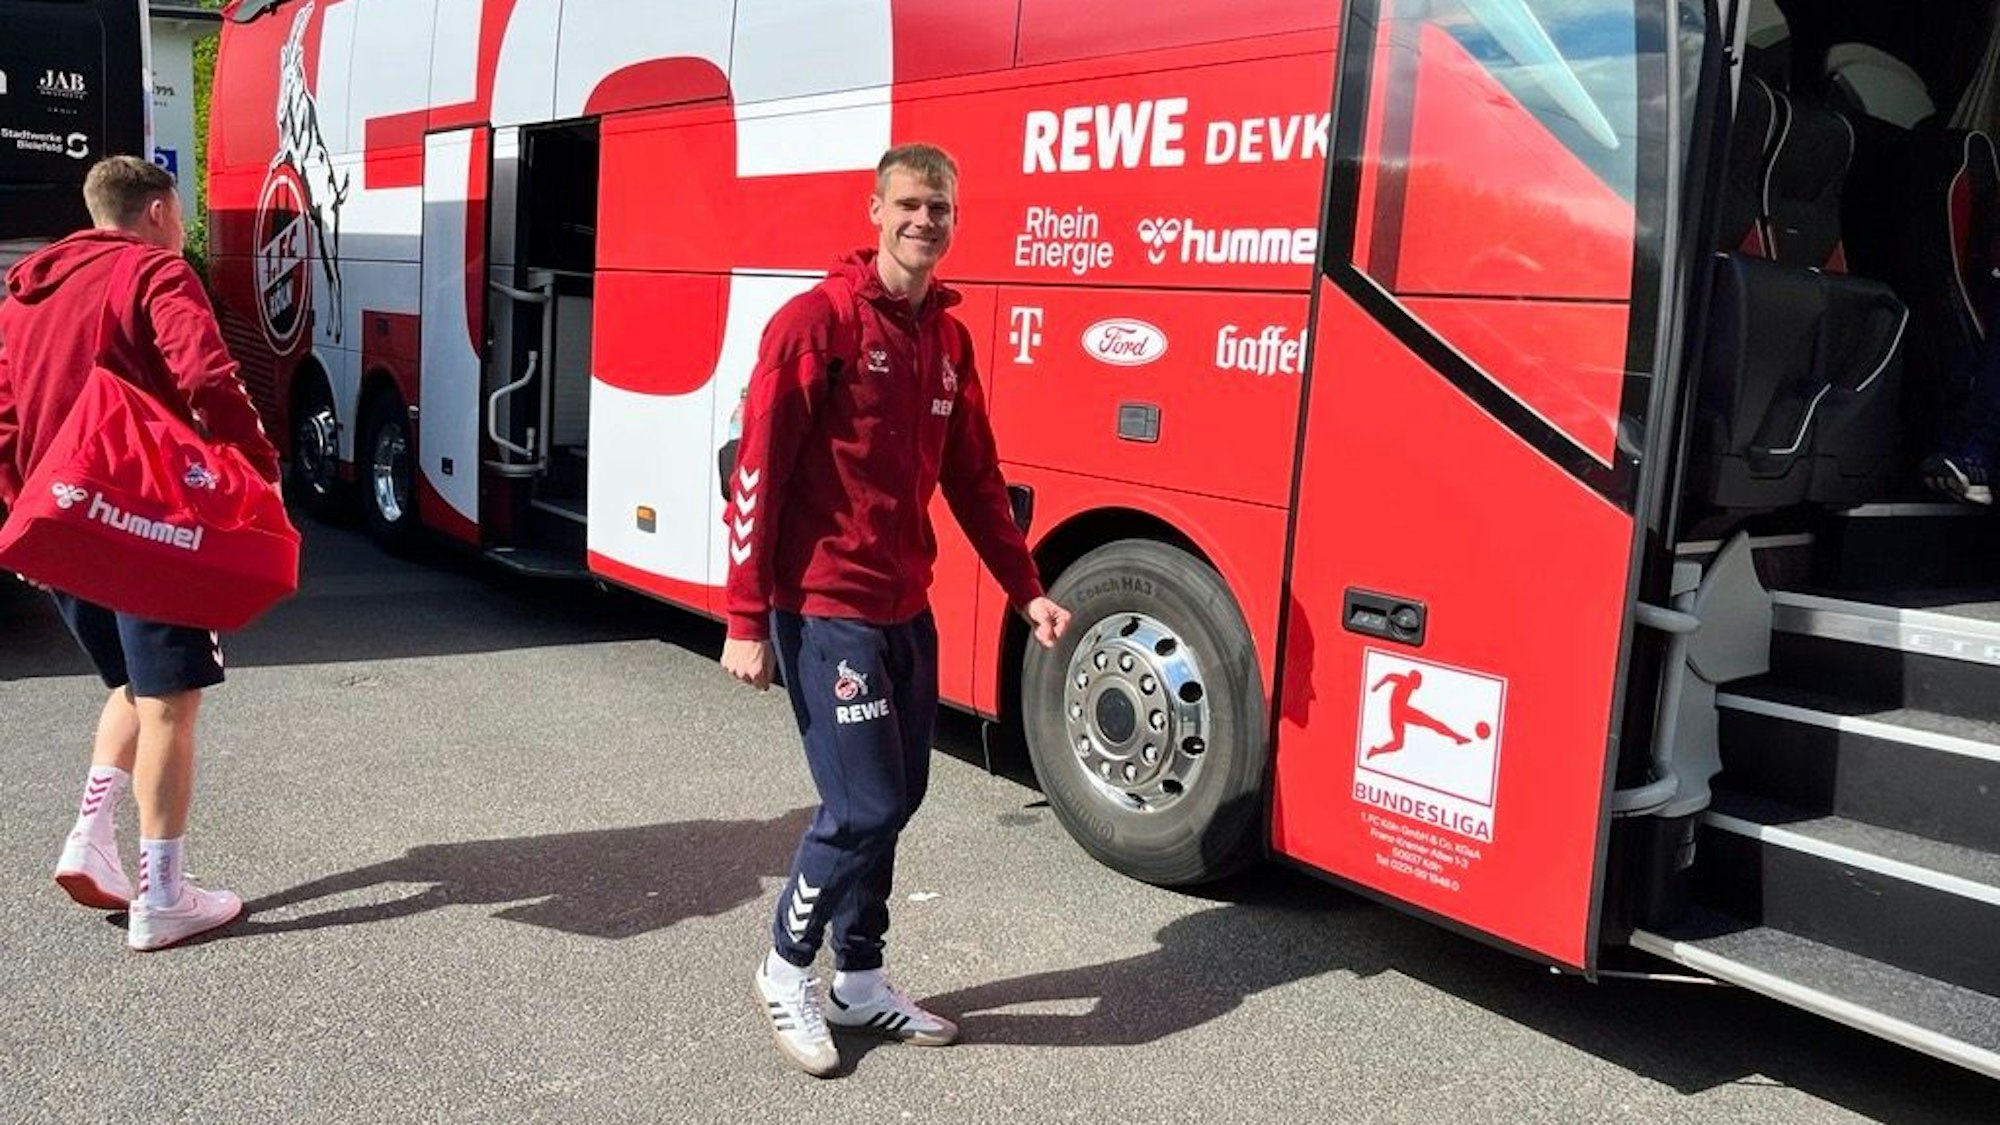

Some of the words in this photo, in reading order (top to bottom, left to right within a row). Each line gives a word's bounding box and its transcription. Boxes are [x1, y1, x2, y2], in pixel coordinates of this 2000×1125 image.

[40, 69, 85, 91] JAB
[1, 127, 62, 143] Stadtwerke
[17, 140, 64, 153] Bielefeld
[1022, 97, 1188, 174] REWE
[1205, 113, 1331, 165] DEVK
[1025, 206, 1098, 238] Rhein
[1014, 235, 1114, 275] Energie
[1009, 306, 1043, 364] T
[1099, 326, 1149, 356] Ford
[1215, 323, 1311, 376] Gaffel
[88, 492, 204, 551] hummel
[1077, 578, 1119, 600] Coach
[835, 698, 890, 724] REWE
[1355, 782, 1490, 840] BUNDESLIGA
